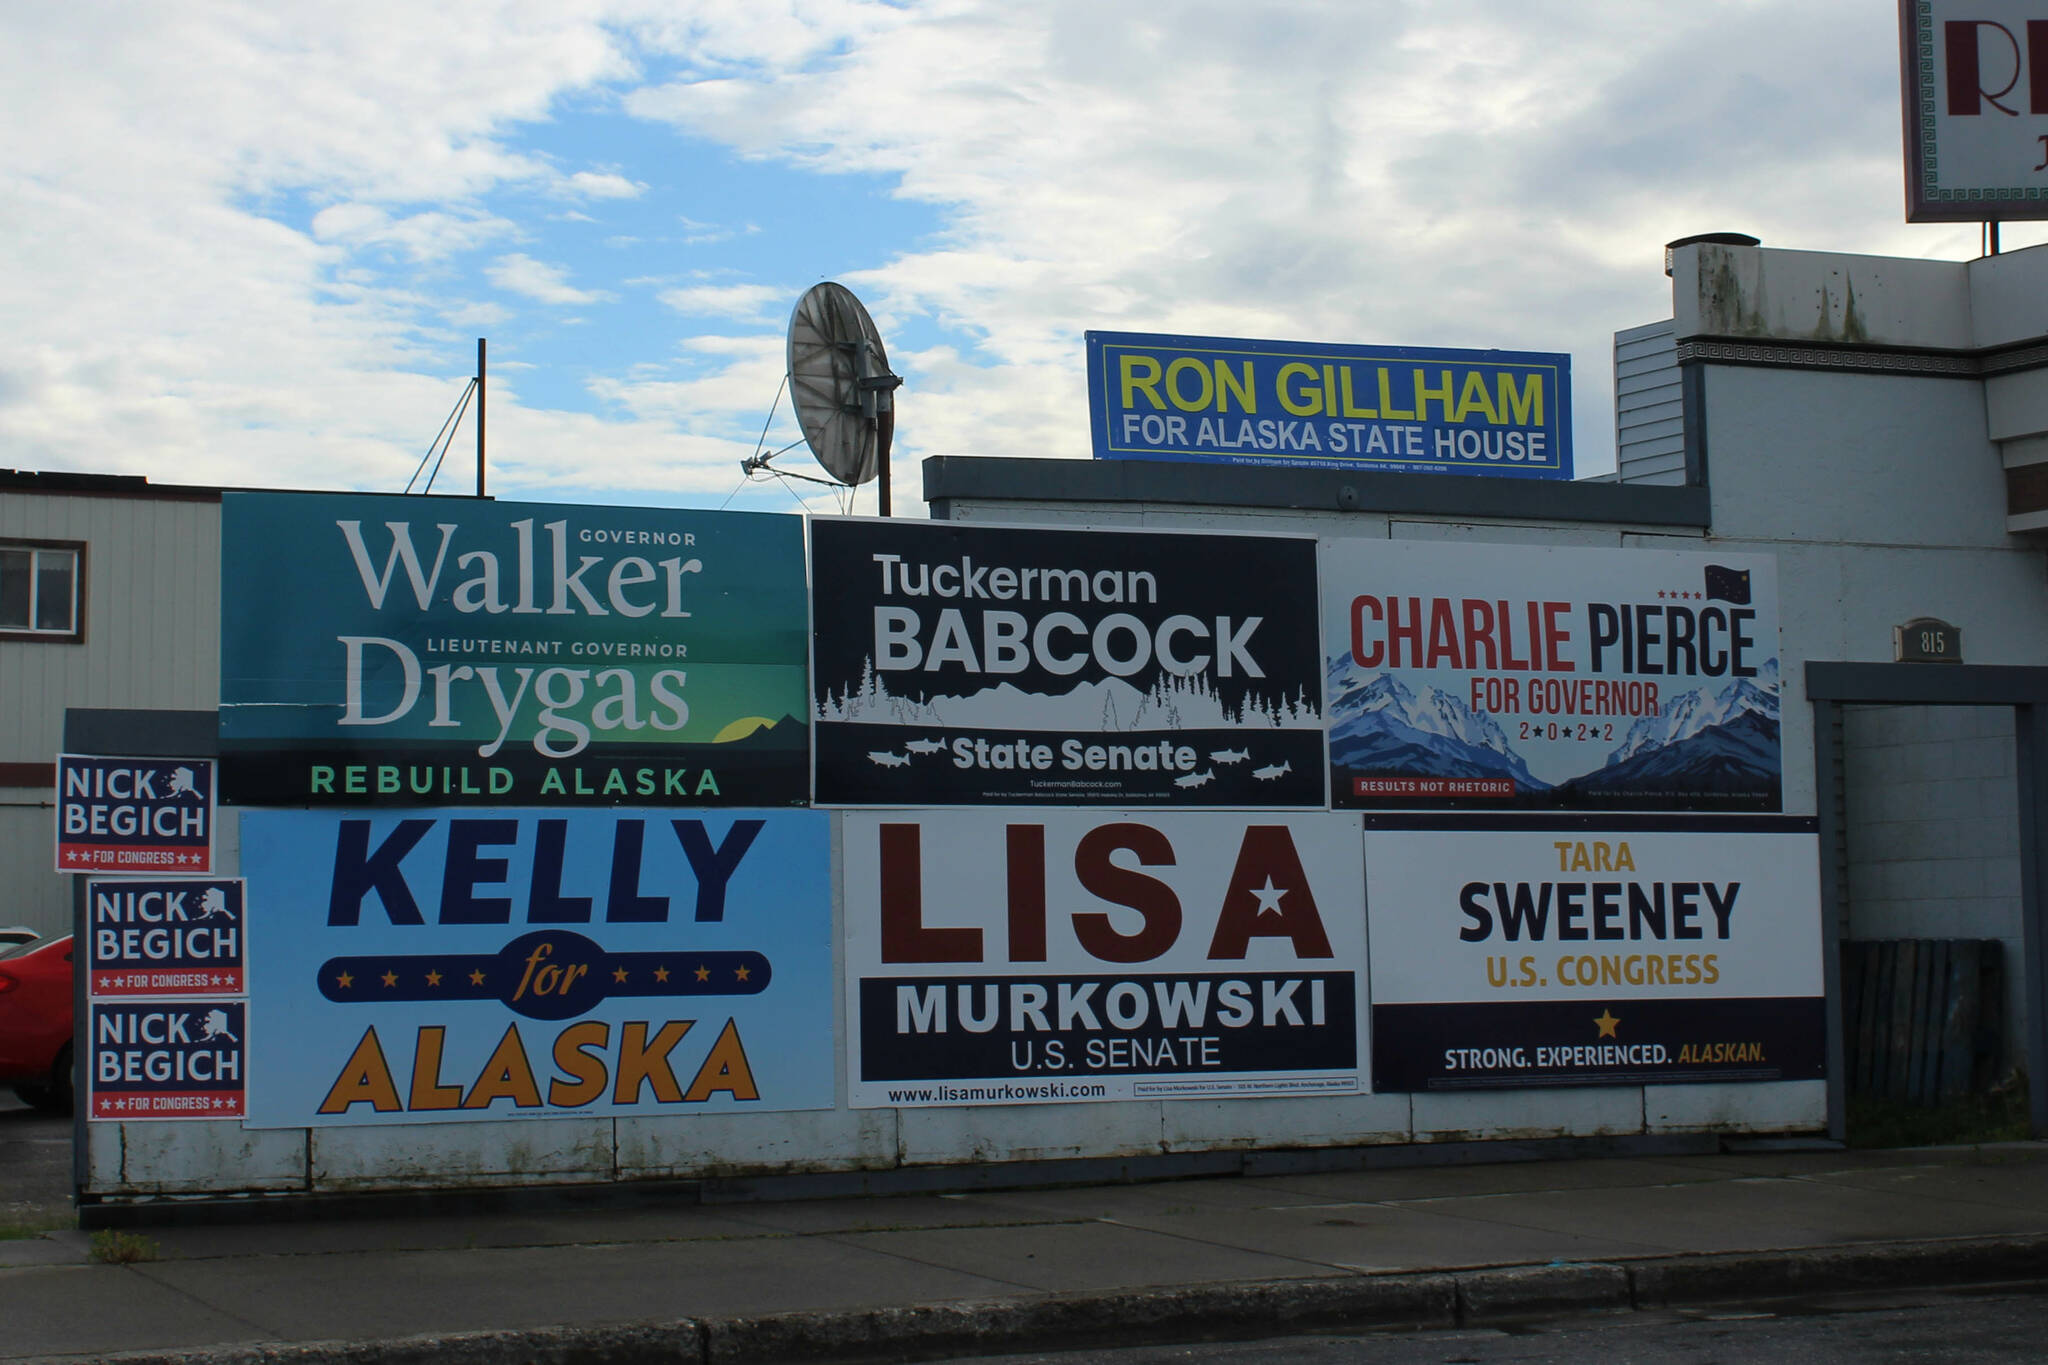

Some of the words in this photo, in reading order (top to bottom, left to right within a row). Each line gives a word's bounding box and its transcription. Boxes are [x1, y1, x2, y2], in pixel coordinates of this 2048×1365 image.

[1944, 20, 2048, 117] R
[1119, 354, 1256, 414] RON
[1275, 362, 1544, 427] GILLHAM
[1123, 414, 1188, 446] FOR
[1195, 417, 1322, 452] ALASKA
[1328, 422, 1425, 457] STATE
[1434, 428, 1547, 462] HOUSE
[579, 528, 697, 547] GOVERNOR
[337, 517, 703, 619] Walker
[873, 553, 1158, 603] Tuckerman
[426, 637, 563, 656] LIEUTENANT
[570, 640, 689, 658] GOVERNOR
[874, 606, 1267, 679] BABCOCK
[1350, 594, 1576, 673] CHARLIE
[1587, 603, 1758, 678] PIERCE
[1921, 631, 1945, 653] 815
[337, 635, 691, 759] Drygas
[1471, 677, 1521, 714] FOR
[1528, 679, 1660, 717] GOVERNOR
[952, 737, 1053, 770] State
[1061, 739, 1198, 771] Senate
[66, 767, 158, 799] NICK
[310, 764, 516, 795] REBUILD
[541, 767, 721, 796] ALASKA
[1029, 779, 1123, 790] TuckermanBabcock.com
[1361, 780, 1417, 793] RESULTS
[1419, 781, 1446, 793] NOT
[1449, 781, 1511, 793] RHETORIC
[65, 804, 205, 837] BEGICH
[94, 849, 115, 866] FOR
[117, 850, 175, 866] CONGRESS
[327, 819, 768, 927] KELLY
[1554, 841, 1636, 873] TARA
[96, 892, 190, 923] NICK
[879, 822, 1335, 964] LISA
[1458, 881, 1741, 942] SWEENEY
[96, 928, 238, 961] BEGICH
[127, 973, 149, 989] FOR
[152, 973, 209, 989] CONGRESS
[511, 942, 589, 1002] for
[1486, 955, 1547, 987] U.S.
[1556, 954, 1720, 986] CONGRESS
[895, 979, 1326, 1034] MURKOWSKI
[99, 1012, 192, 1045] NICK
[98, 1050, 240, 1083] BEGICH
[316, 1017, 761, 1116] ALASKA
[1011, 1040, 1075, 1070] U.S.
[1085, 1036, 1222, 1068] SENATE
[1445, 1047, 1532, 1070] STRONG.
[1536, 1044, 1673, 1067] EXPERIENCED.
[1678, 1042, 1766, 1063] ALASKAN.
[128, 1096, 151, 1112] FOR
[153, 1095, 210, 1112] CONGRESS
[888, 1082, 1106, 1103] www.lisamurkowski.com
